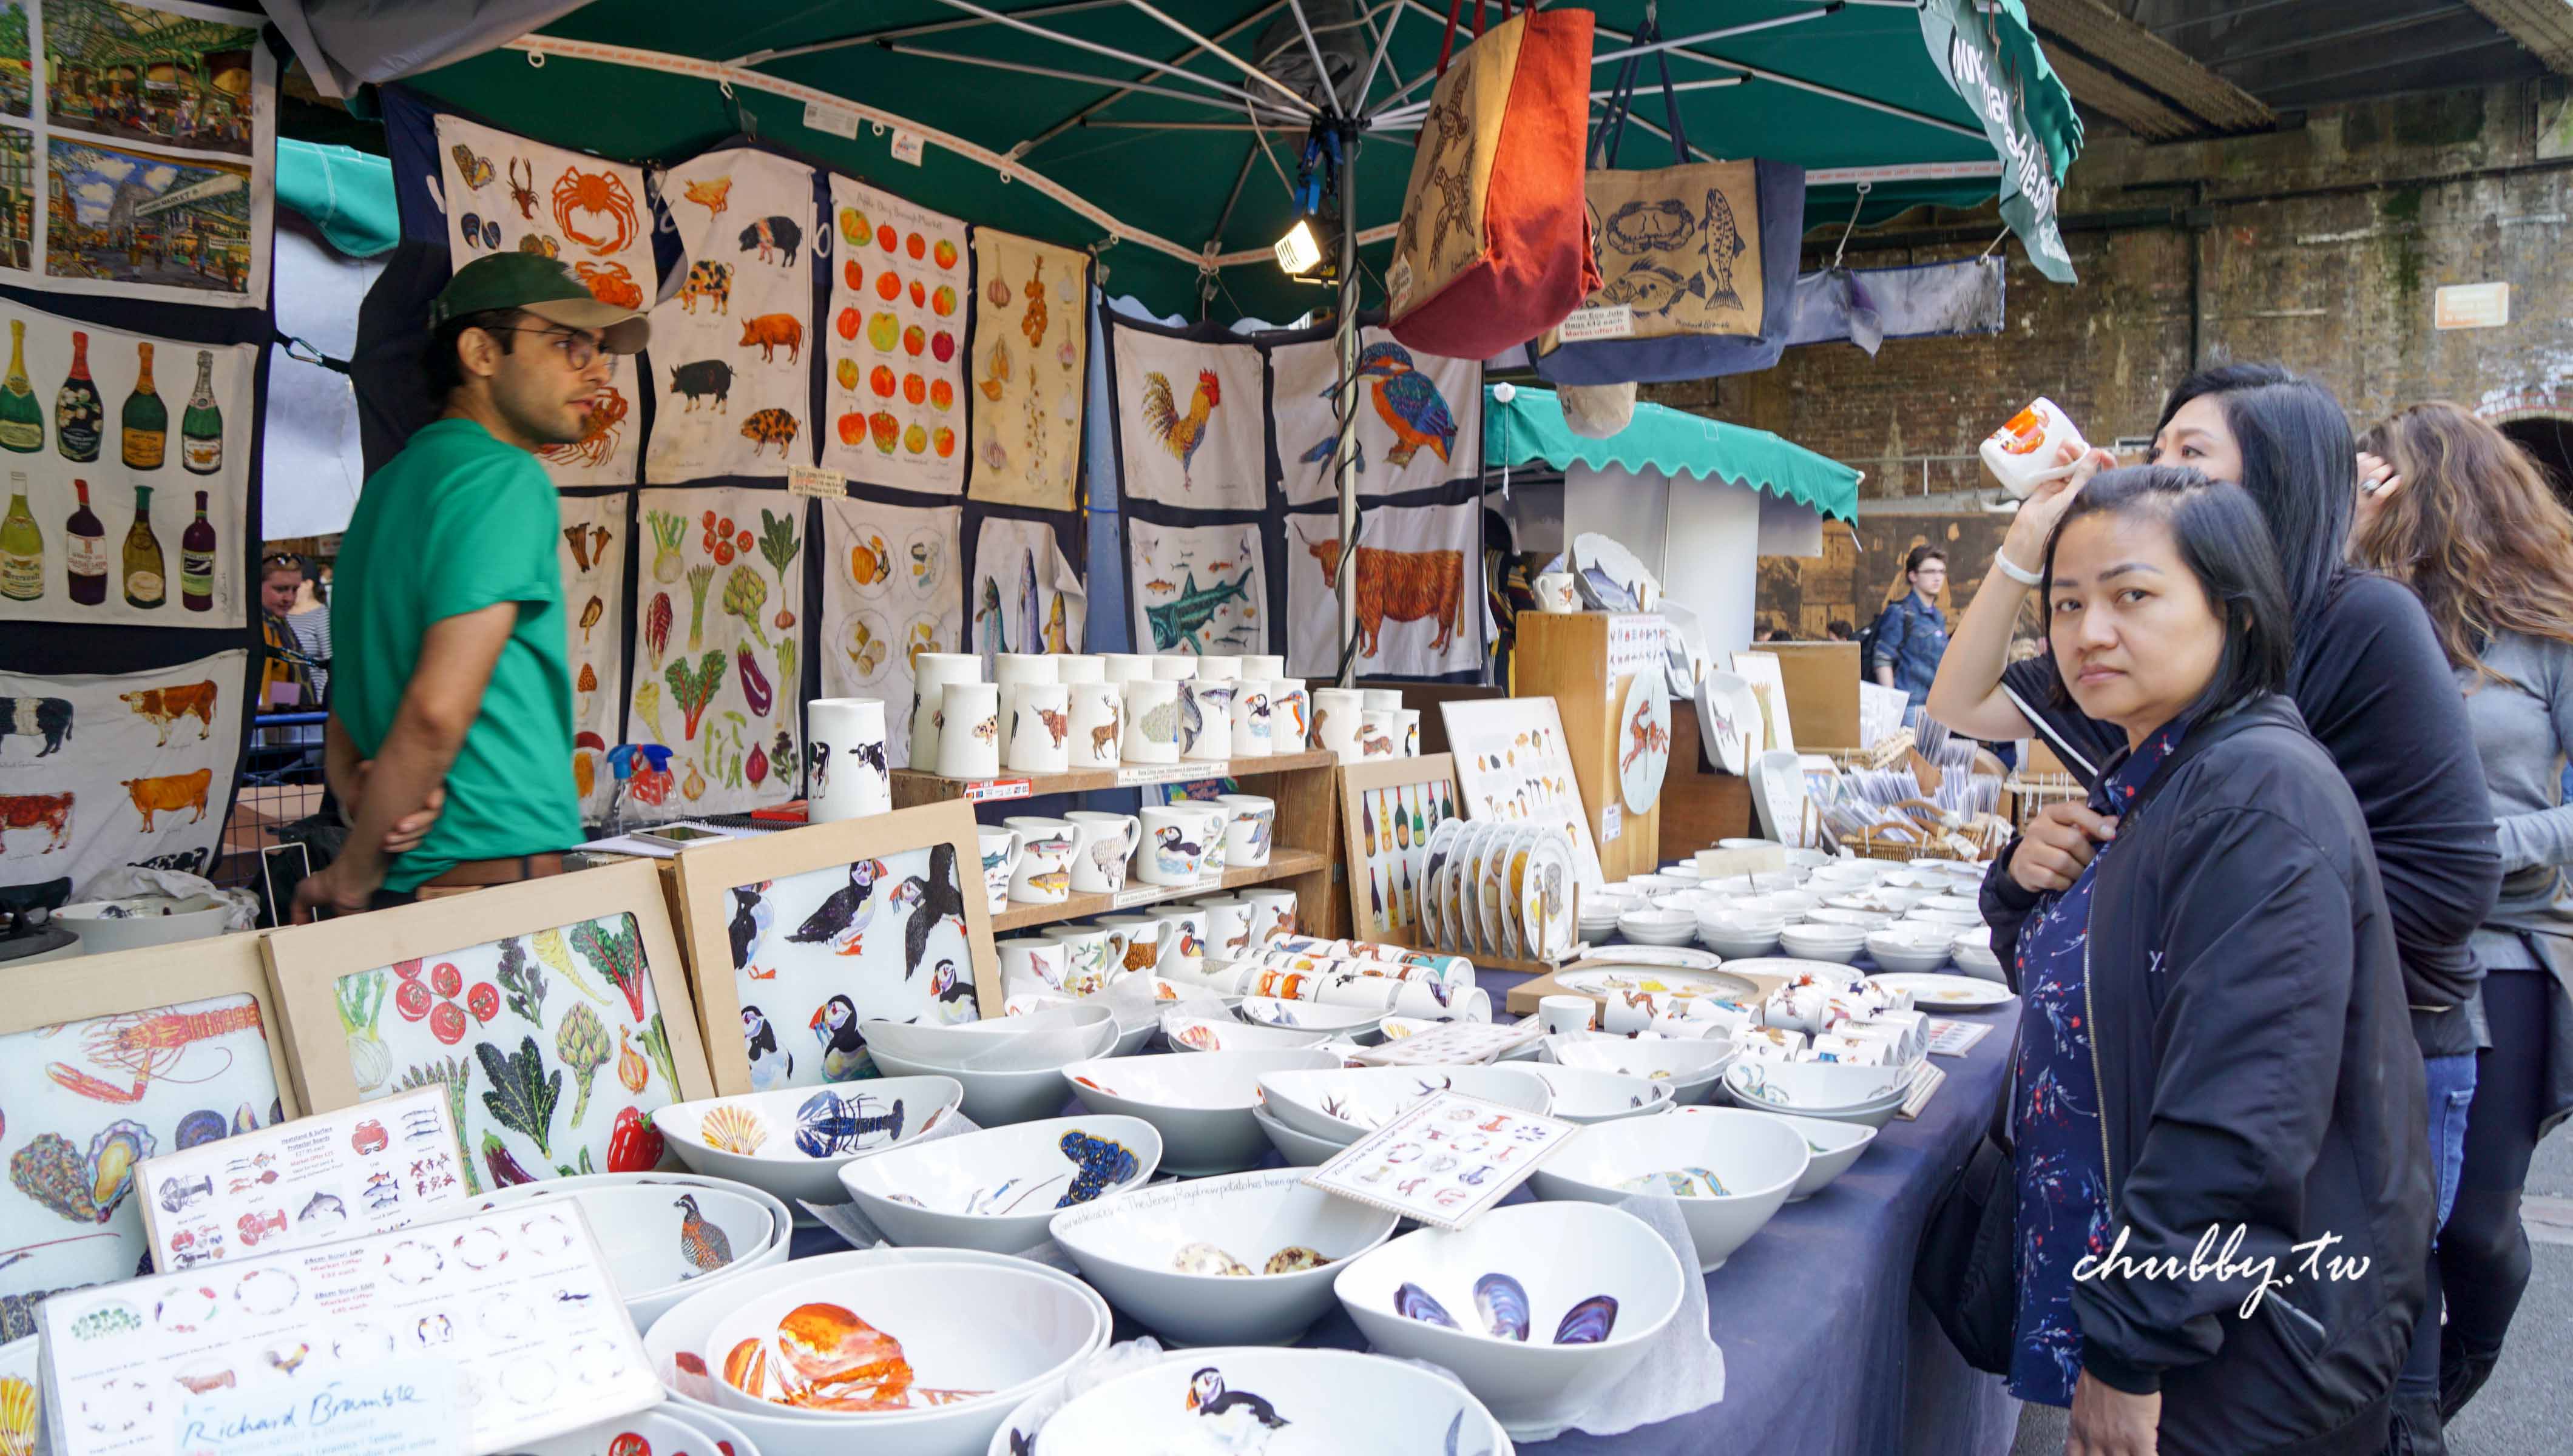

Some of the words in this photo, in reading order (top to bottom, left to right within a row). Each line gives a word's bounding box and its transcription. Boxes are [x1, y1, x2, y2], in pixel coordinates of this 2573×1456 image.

[1565, 329, 1593, 337] Market
[182, 1404, 297, 1448] Richard
[309, 1384, 427, 1426] Bramble
